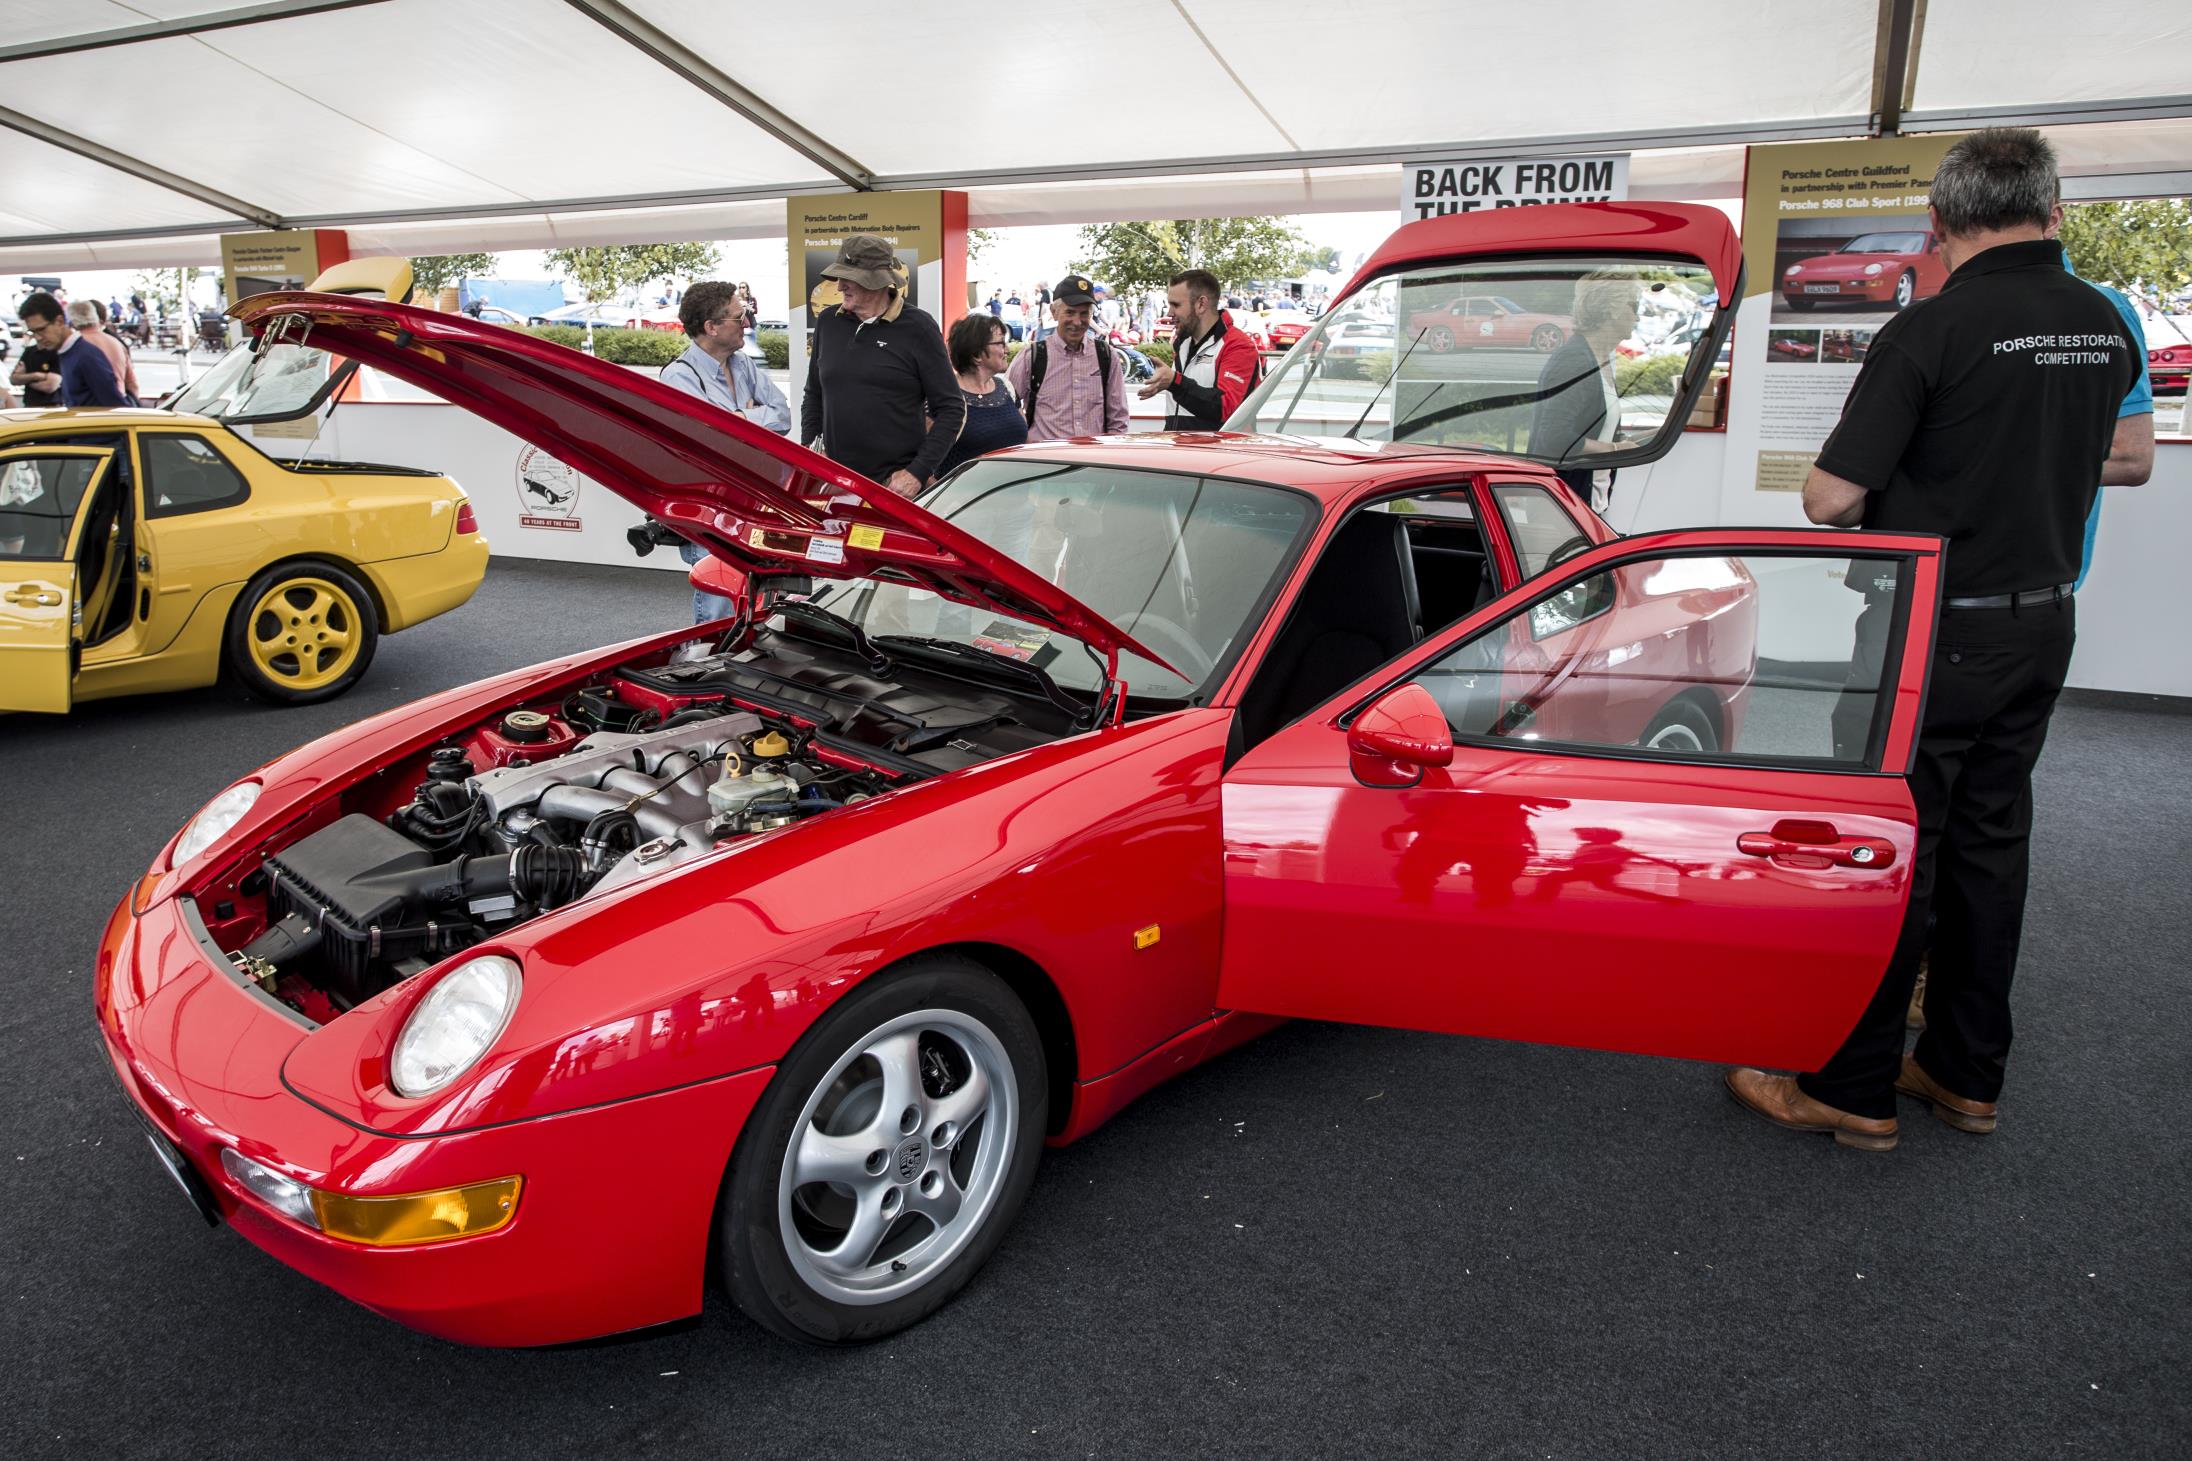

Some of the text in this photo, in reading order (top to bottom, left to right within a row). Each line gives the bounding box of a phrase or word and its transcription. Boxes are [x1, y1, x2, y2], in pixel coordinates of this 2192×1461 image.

[1415, 161, 1614, 198] BACK FROM
[1782, 164, 1910, 180] Porsche Centre Guildford
[1781, 178, 1934, 194] in partnership with Premier Pane
[1779, 194, 1930, 210] Porsche 968 Club Sport (199
[804, 212, 869, 222] Porsche Centre Cardiff
[804, 238, 829, 247] Porsche
[1993, 334, 2128, 355] PORSCHE RESTORATIO
[2035, 352, 2110, 365] COMPETITION
